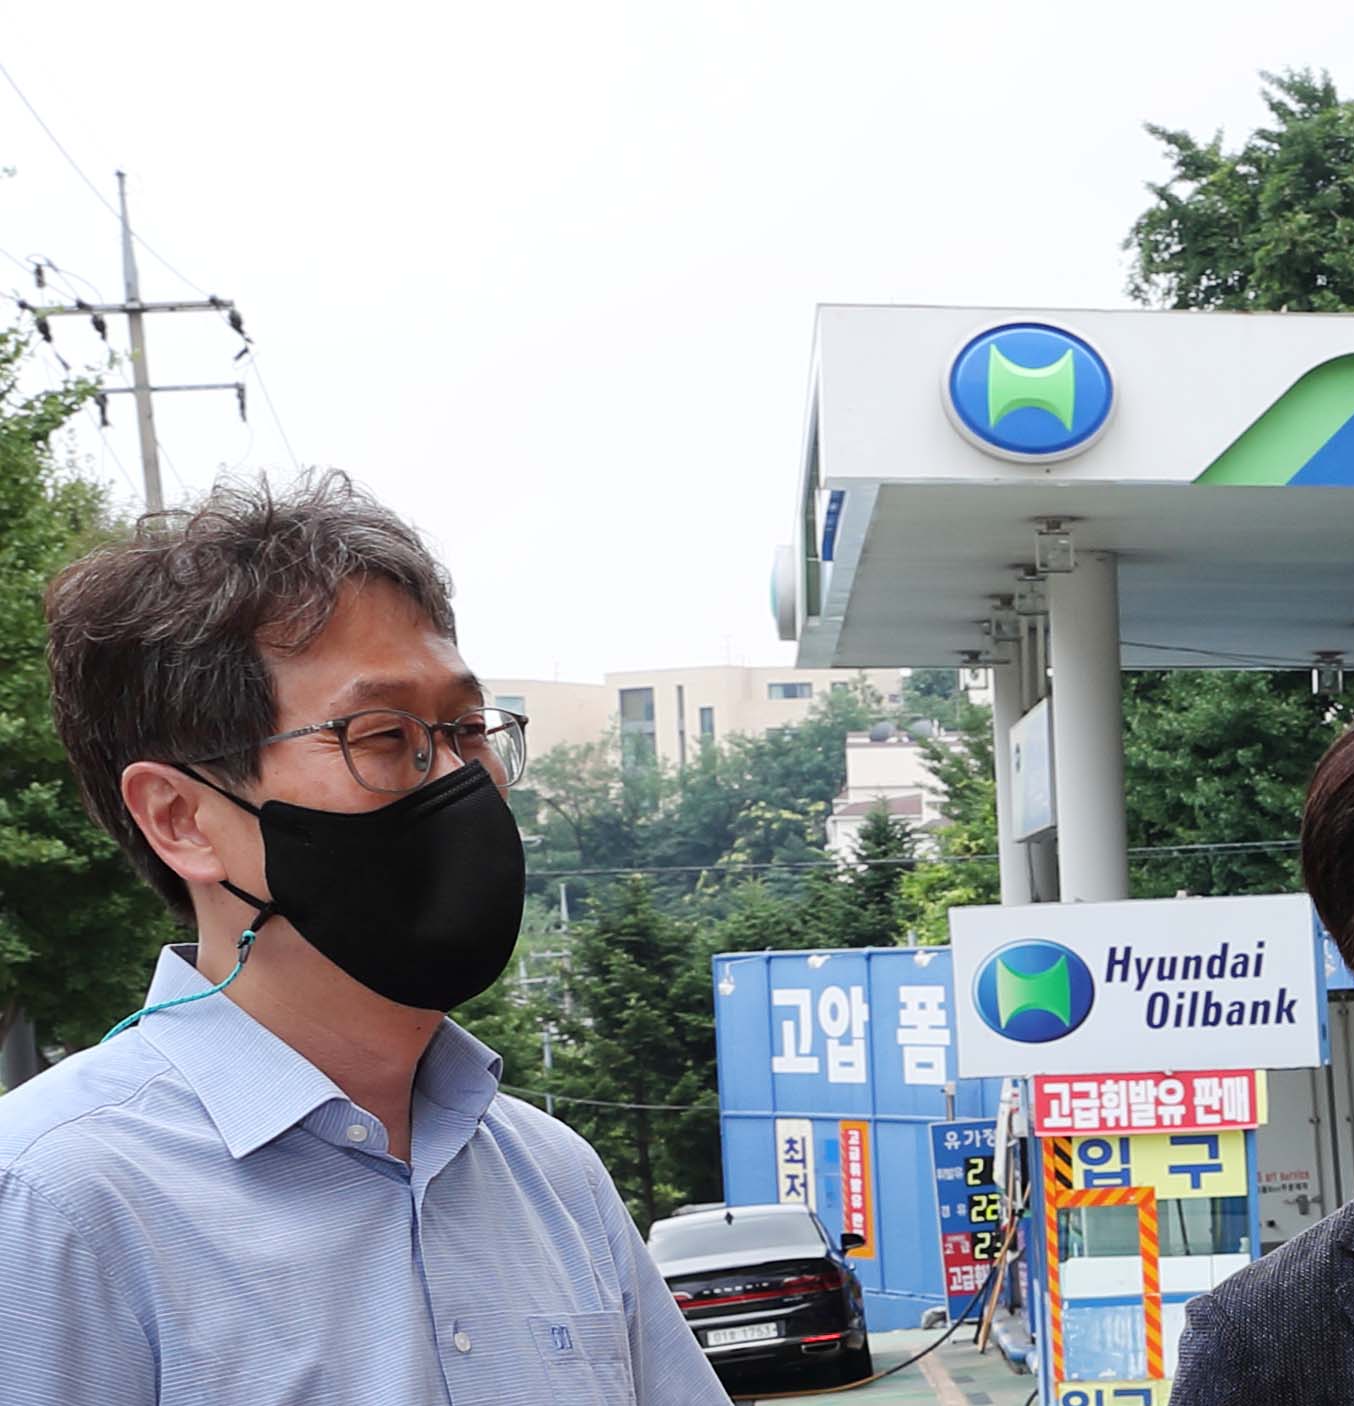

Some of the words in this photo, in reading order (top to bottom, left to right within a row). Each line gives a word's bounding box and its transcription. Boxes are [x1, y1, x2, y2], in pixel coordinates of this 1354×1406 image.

[1104, 941, 1265, 986] Hyundai
[771, 985, 867, 1085] 고압
[897, 985, 951, 1085] 폼
[1146, 989, 1297, 1030] Oilbank
[1043, 1078, 1186, 1130] 고급휘발유
[1193, 1075, 1251, 1125] 판매
[1077, 1135, 1223, 1189] 입구
